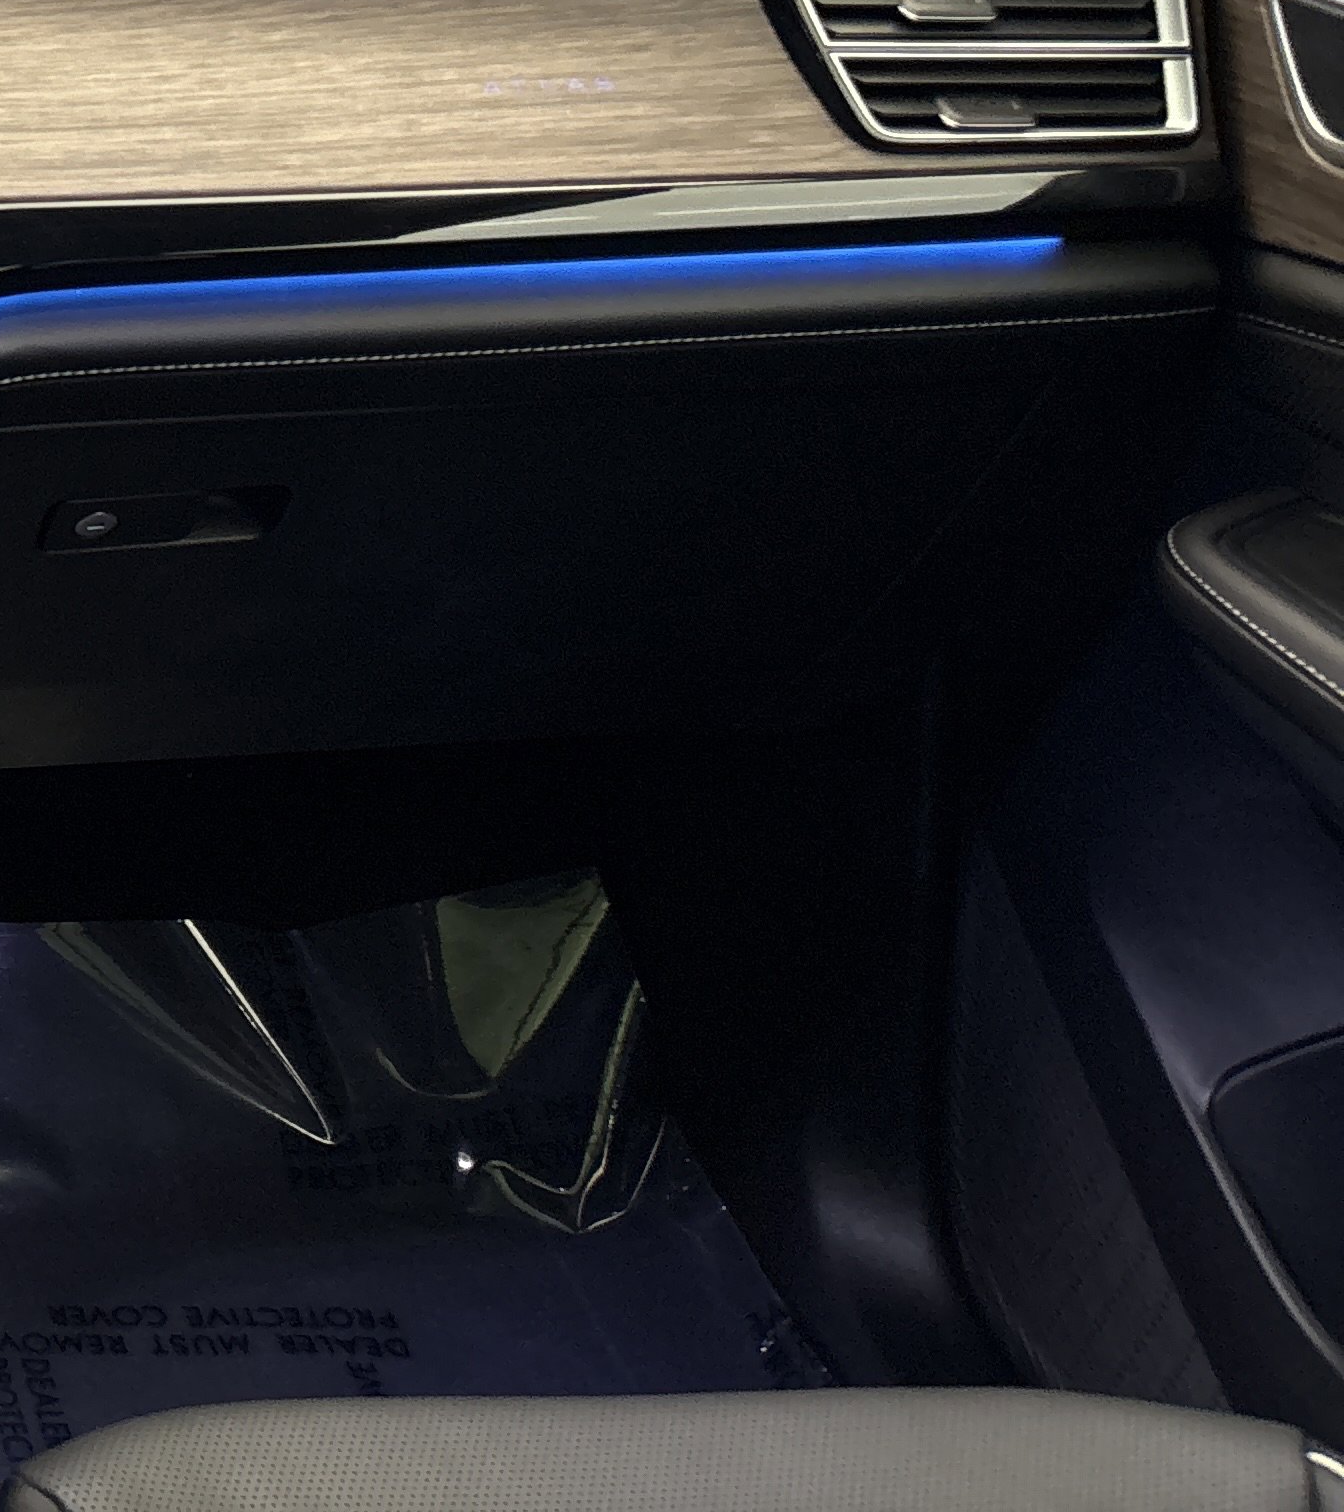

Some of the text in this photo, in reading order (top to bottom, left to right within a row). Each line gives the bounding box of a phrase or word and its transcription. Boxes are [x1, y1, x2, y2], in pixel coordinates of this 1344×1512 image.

[47, 1303, 400, 1330] PROTECTIVE COVER
[151, 1333, 250, 1356] MUST
[276, 1334, 411, 1359] DEALER
